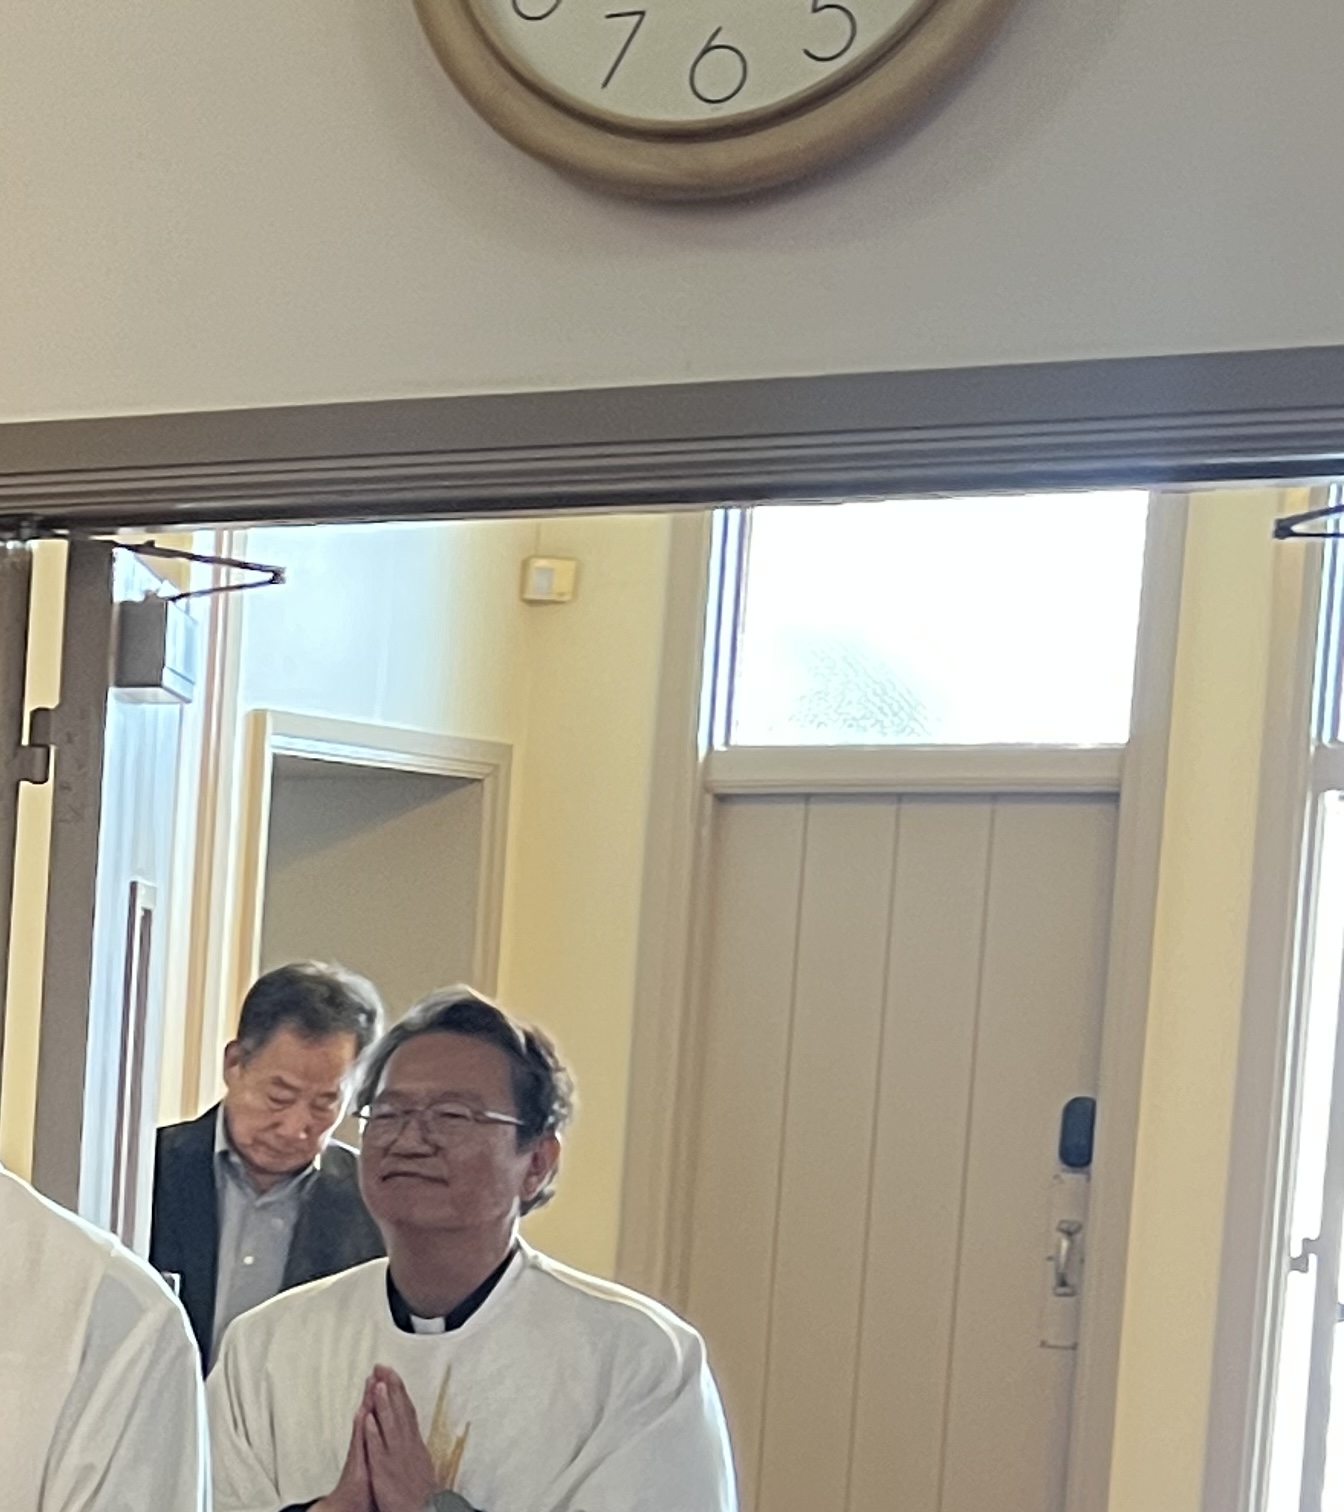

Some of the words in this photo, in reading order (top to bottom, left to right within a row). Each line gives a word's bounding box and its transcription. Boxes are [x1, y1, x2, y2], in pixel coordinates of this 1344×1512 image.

[602, 10, 646, 89] 7
[689, 26, 748, 104] 6
[803, 0, 857, 62] 5
